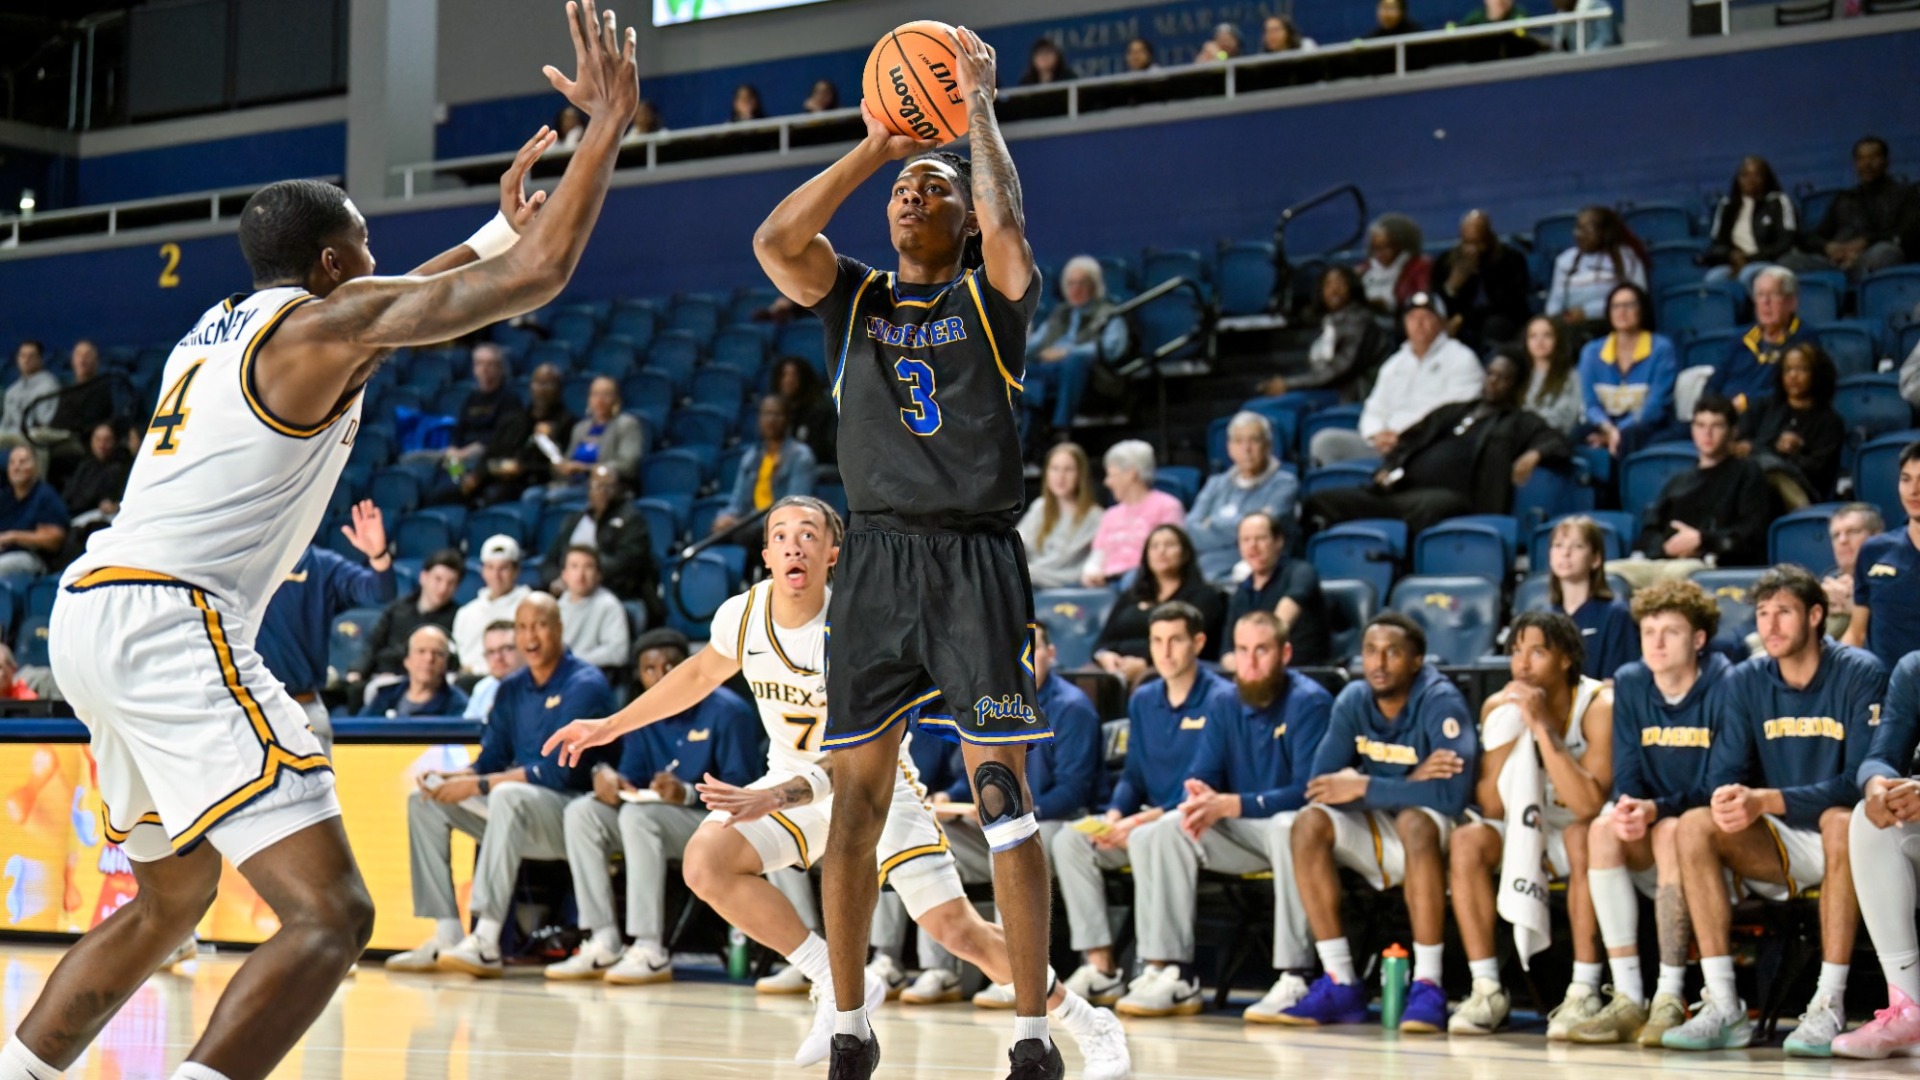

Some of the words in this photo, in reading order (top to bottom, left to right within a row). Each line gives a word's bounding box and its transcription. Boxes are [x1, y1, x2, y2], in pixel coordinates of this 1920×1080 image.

[889, 64, 940, 139] Wilson
[929, 62, 964, 104] EVO
[158, 243, 181, 288] 2
[146, 357, 208, 456] 4
[893, 355, 943, 436] 3
[751, 680, 827, 708] DREX
[973, 693, 1037, 727] Pride
[781, 713, 819, 751] 7
[1441, 716, 1461, 739] 0
